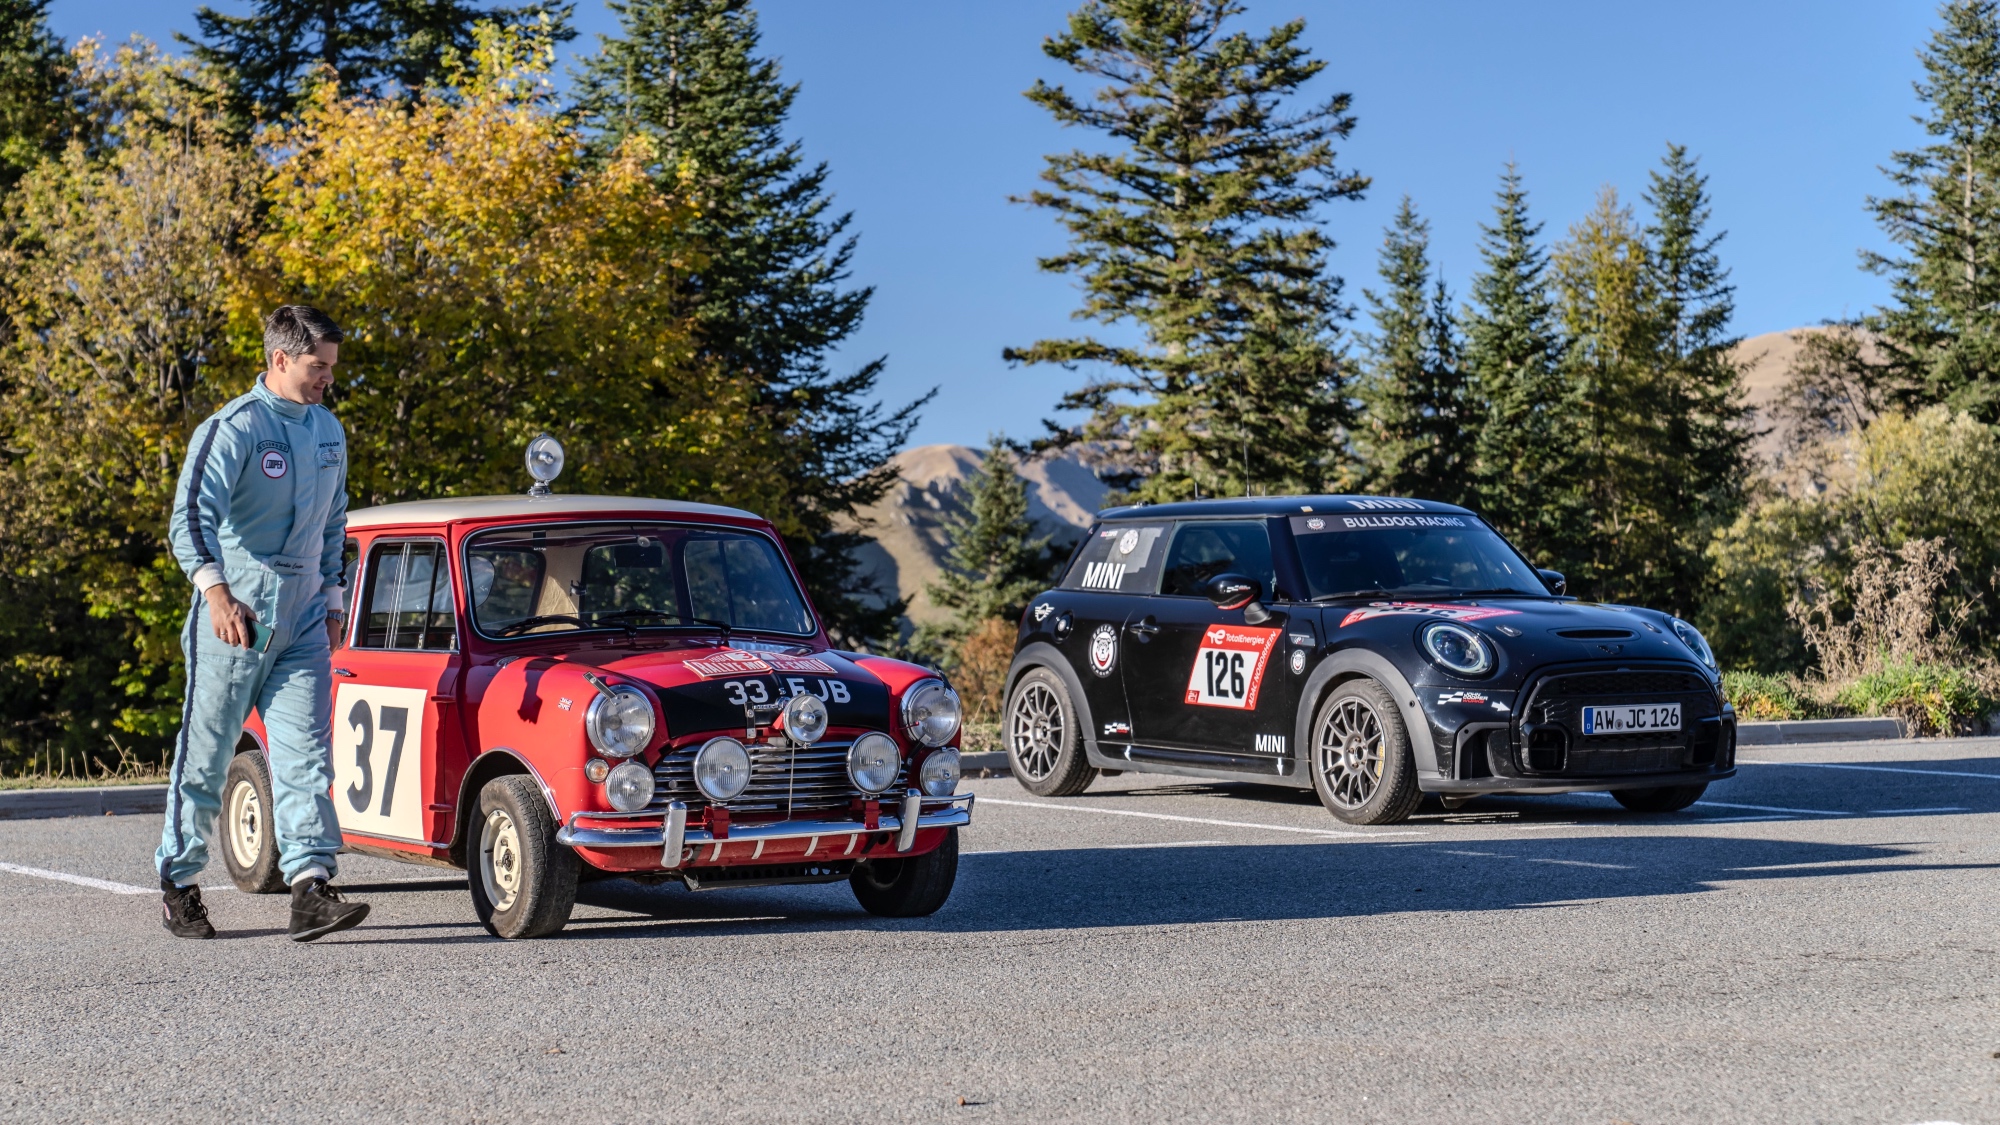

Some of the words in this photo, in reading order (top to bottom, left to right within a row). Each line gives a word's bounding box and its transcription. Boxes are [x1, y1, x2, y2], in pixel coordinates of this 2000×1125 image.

[1347, 500, 1425, 510] MINI
[1343, 517, 1417, 528] BULLDOG
[1415, 517, 1466, 527] RACING
[1081, 562, 1126, 590] MINI
[1226, 633, 1265, 646] TotalEnergies
[691, 661, 746, 674] RALLYE
[1205, 650, 1245, 699] 126
[1248, 682, 1258, 707] ADAC
[1255, 631, 1277, 682] NORDRHEIN
[724, 679, 769, 705] 33
[1594, 710, 1615, 730] AW
[1626, 708, 1647, 729] JC
[1650, 707, 1679, 728] 126
[1256, 734, 1285, 753] MINI
[346, 698, 409, 817] 37
